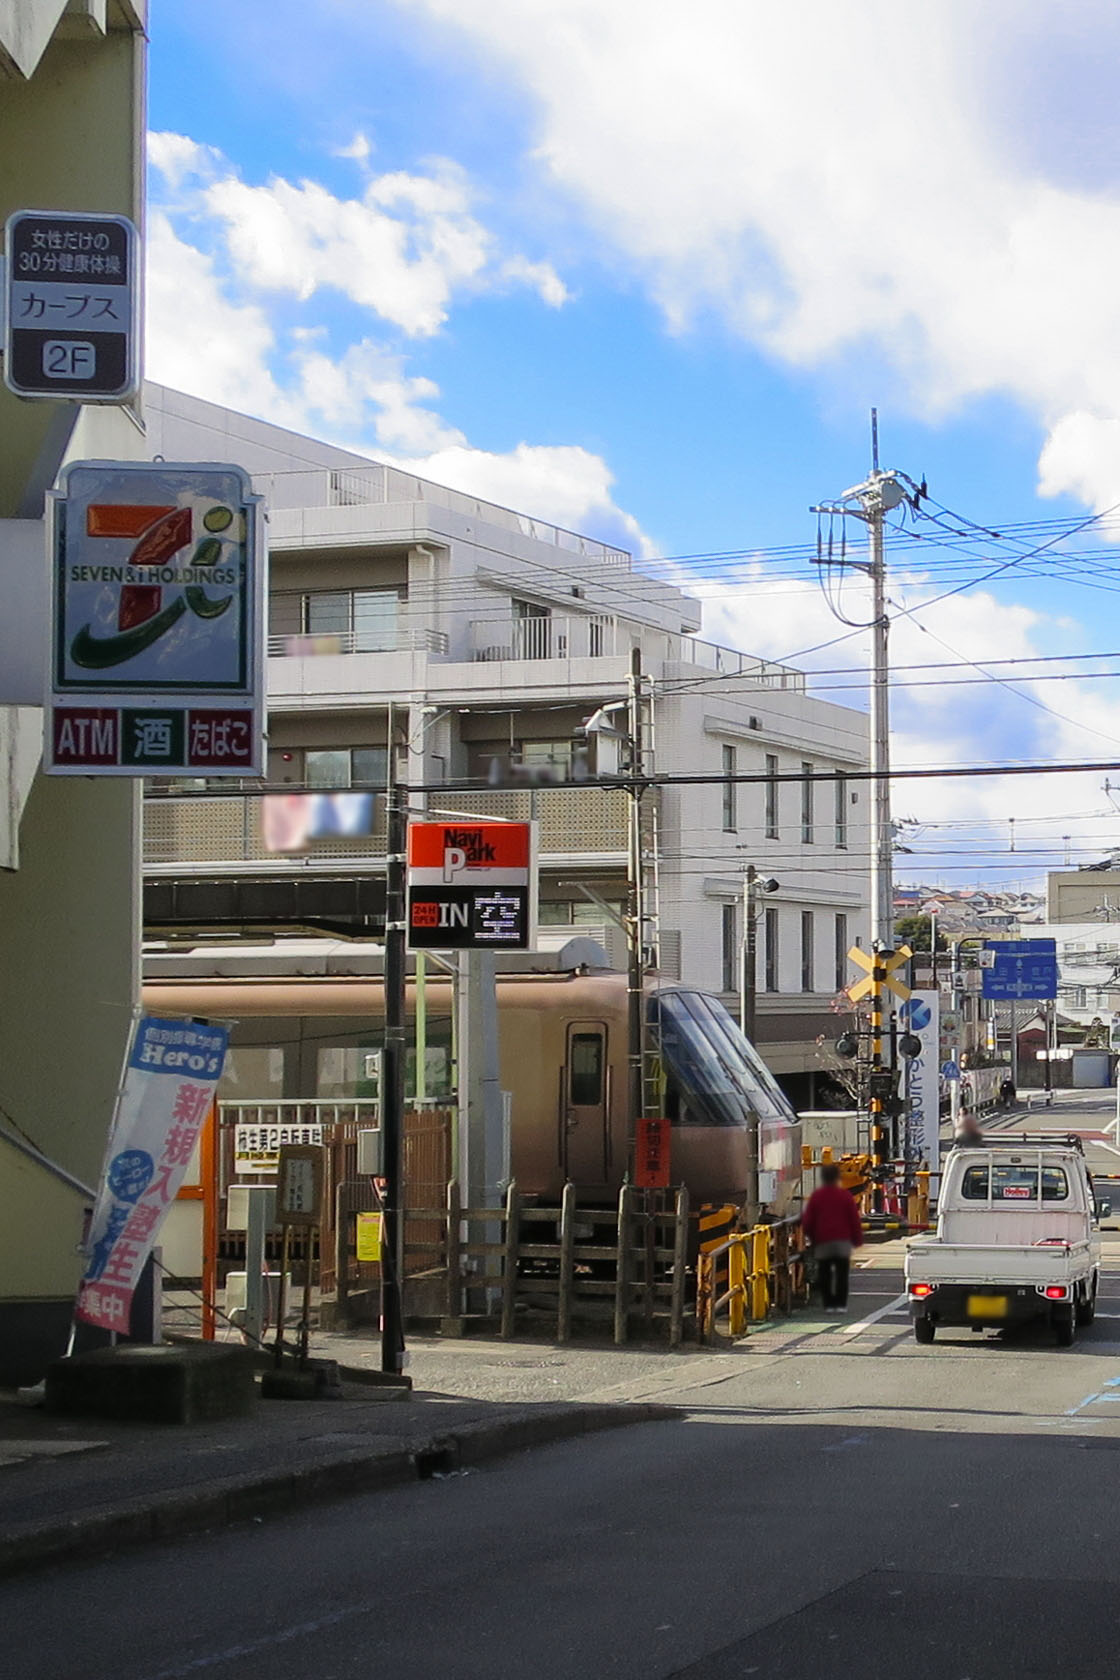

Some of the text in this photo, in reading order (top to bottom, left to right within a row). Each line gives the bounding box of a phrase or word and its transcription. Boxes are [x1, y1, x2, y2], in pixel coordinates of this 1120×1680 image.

[31, 229, 110, 250] 女性だけの
[19, 252, 121, 274] 30分健康体操
[20, 292, 119, 320] カーブス
[49, 346, 90, 373] 2F
[148, 566, 235, 584] HOLDINGS
[57, 718, 115, 756] ATM
[134, 718, 172, 757] 酒
[191, 718, 249, 757] たばこ
[444, 829, 483, 849] Navi
[443, 844, 497, 883] Park
[438, 903, 468, 928] IN
[474, 891, 520, 941] 空
[139, 1042, 218, 1073] Hero's
